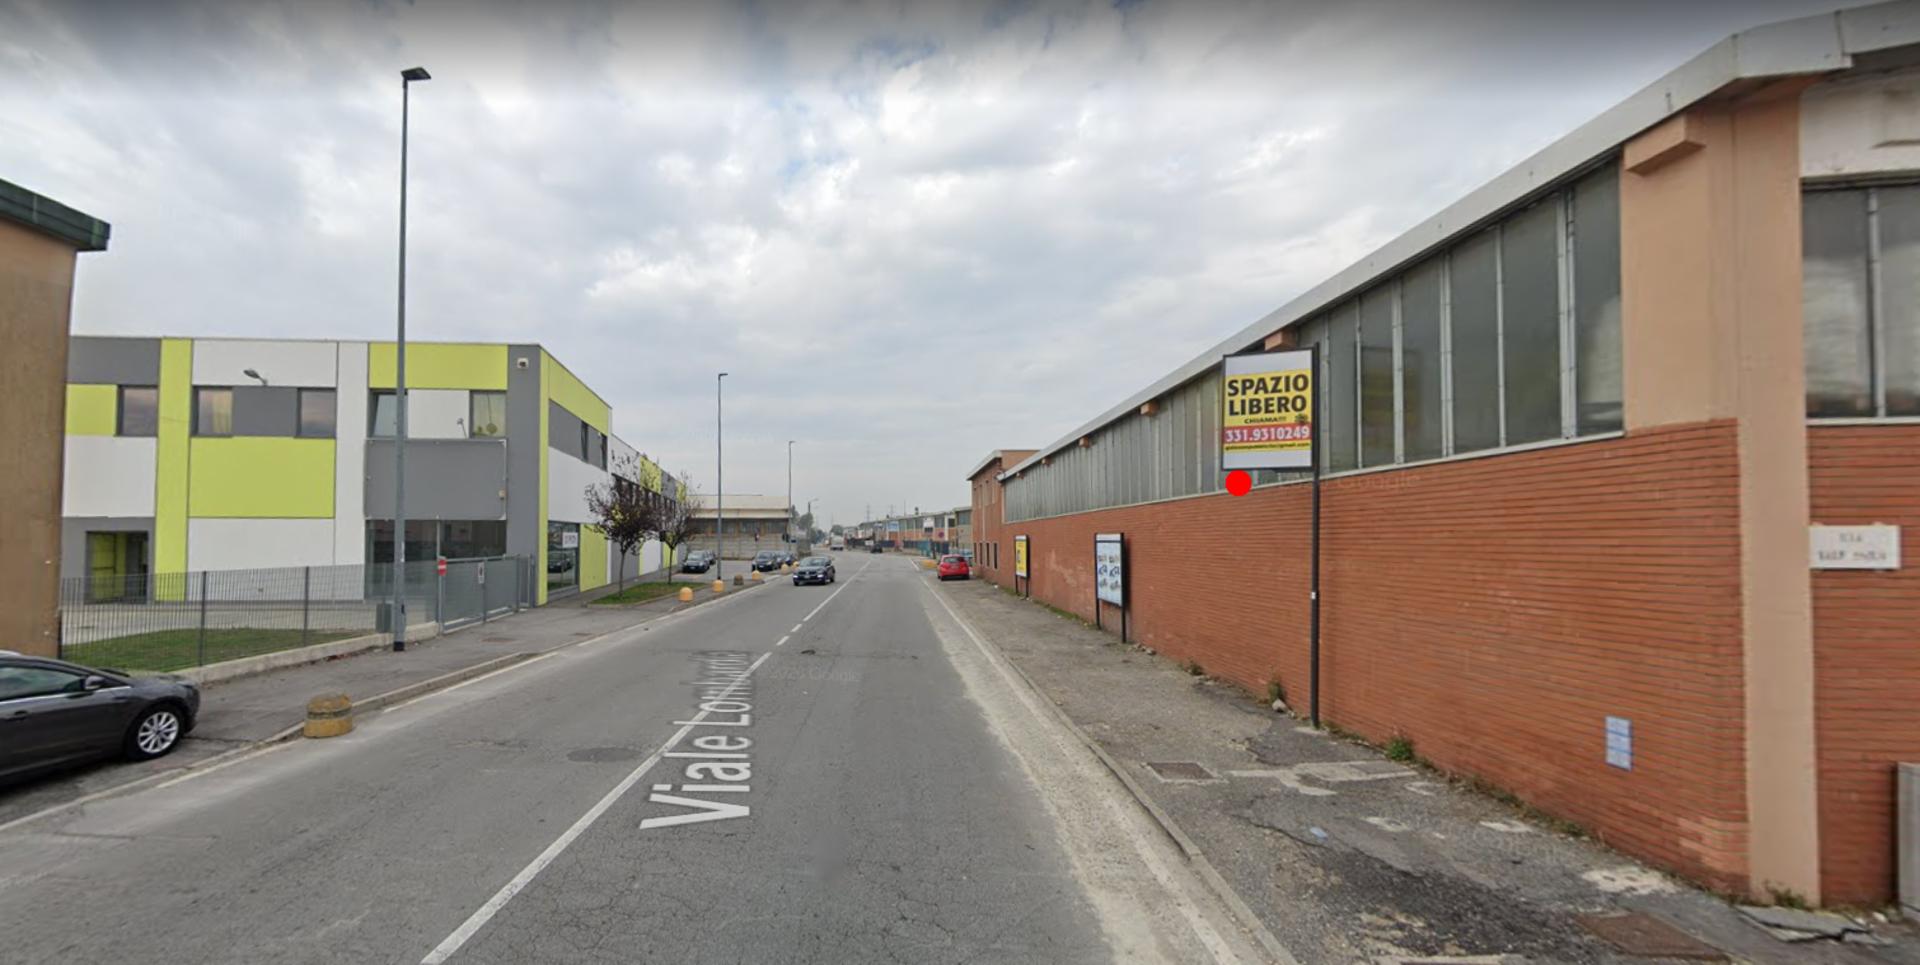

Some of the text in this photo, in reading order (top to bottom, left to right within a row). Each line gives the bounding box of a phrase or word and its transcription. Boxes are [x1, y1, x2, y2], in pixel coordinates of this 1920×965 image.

[1227, 374, 1309, 396] SPAZIO
[1229, 395, 1307, 416] LIBERO
[1225, 426, 1310, 442] 331.9310249
